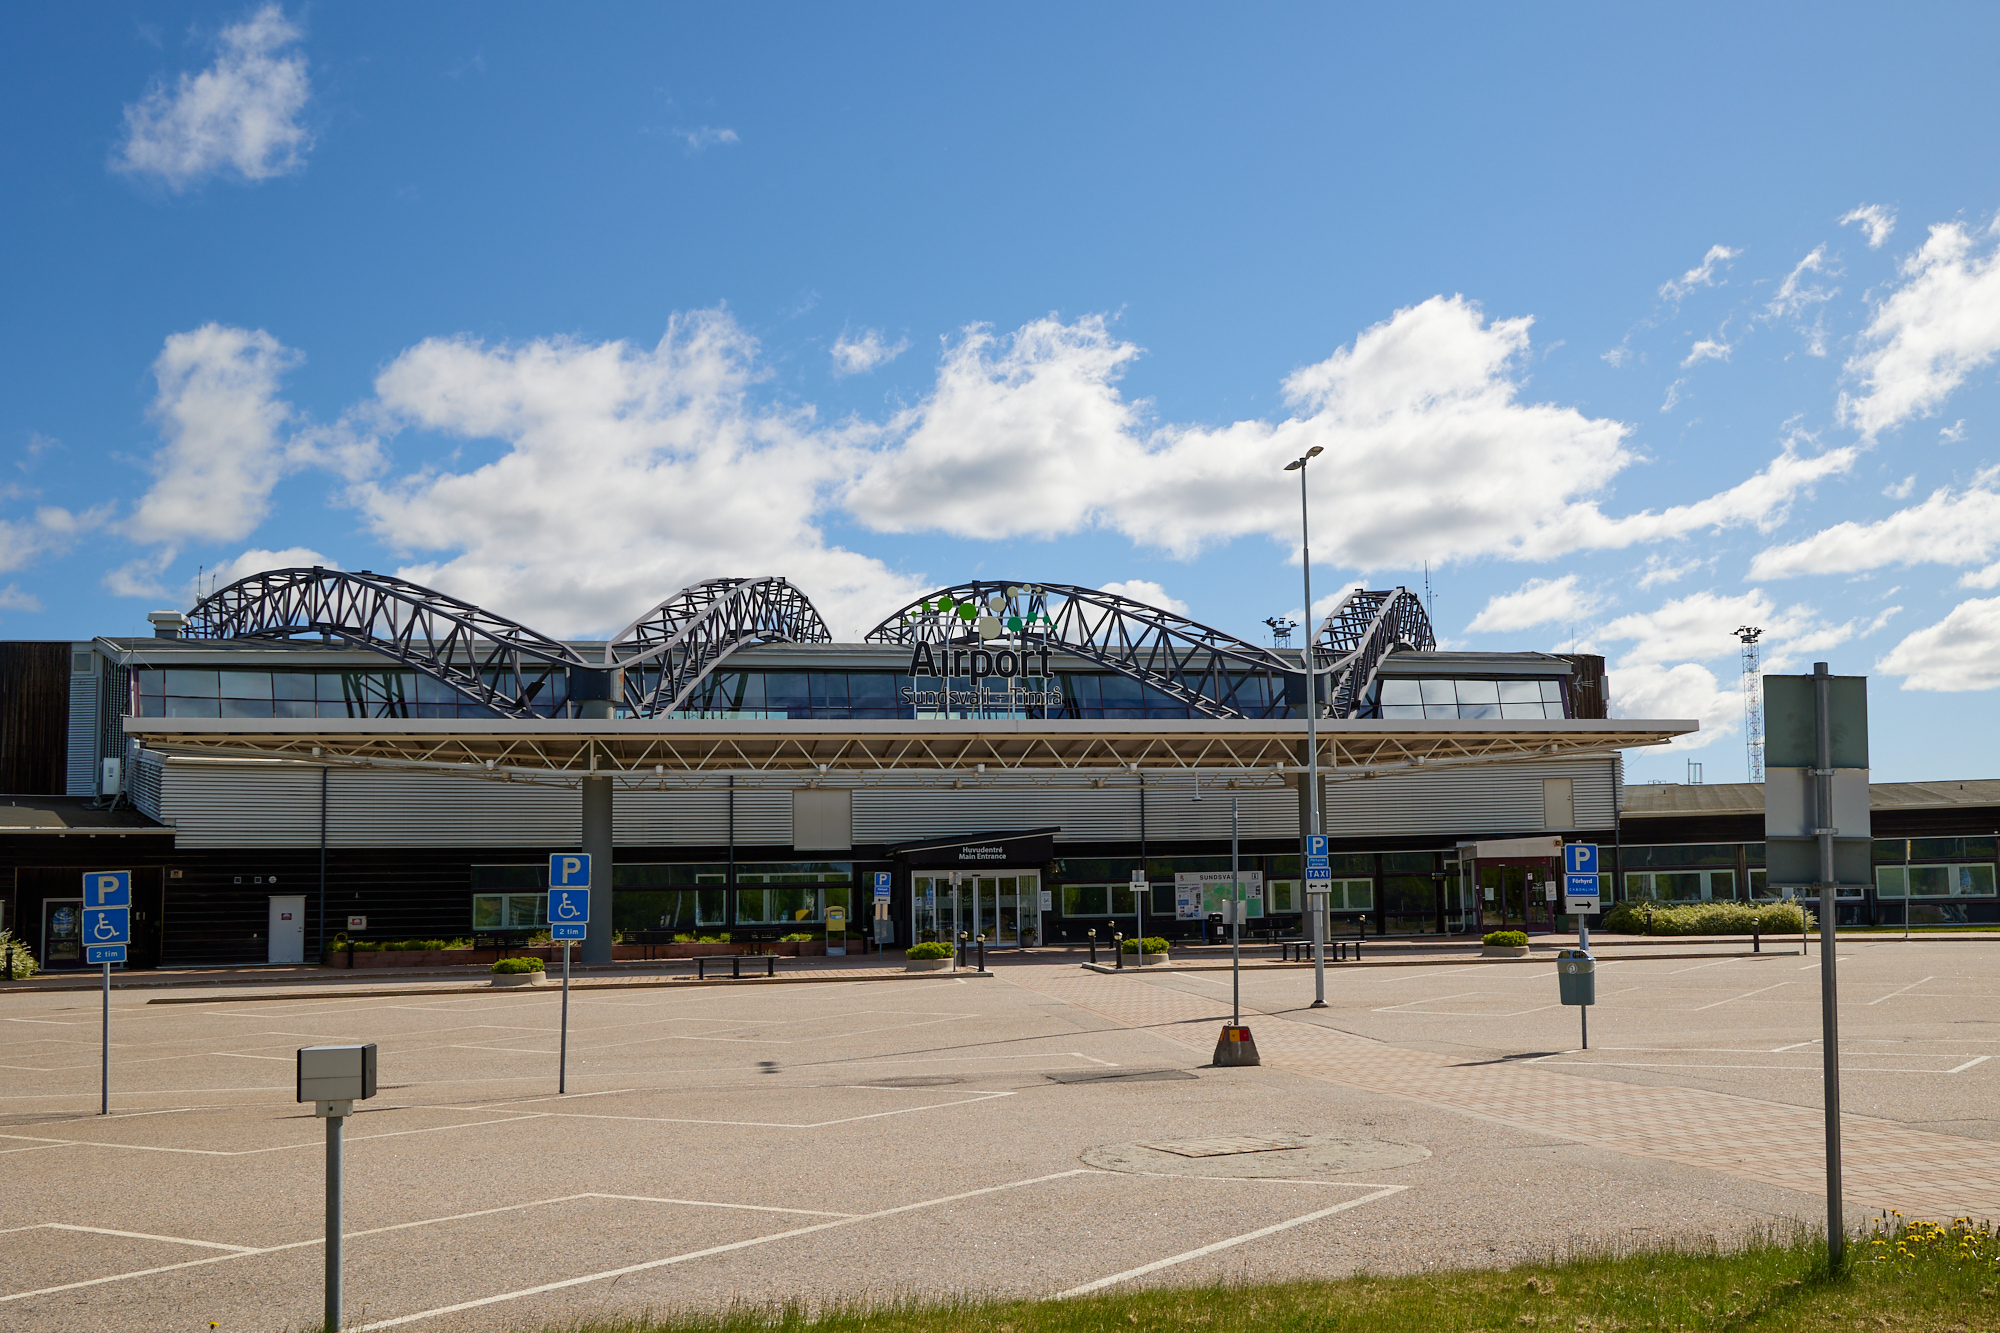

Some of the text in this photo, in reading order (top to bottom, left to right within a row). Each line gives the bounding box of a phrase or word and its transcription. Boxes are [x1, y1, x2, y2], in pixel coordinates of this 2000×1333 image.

[908, 640, 1055, 686] Airport
[901, 687, 990, 705] Sundsvall
[1010, 686, 1063, 705] Timrå
[1312, 837, 1325, 855] P
[1575, 847, 1591, 871] P
[562, 857, 582, 884] P
[879, 873, 888, 885] P
[1308, 870, 1329, 878] TAXI
[98, 875, 120, 904] P
